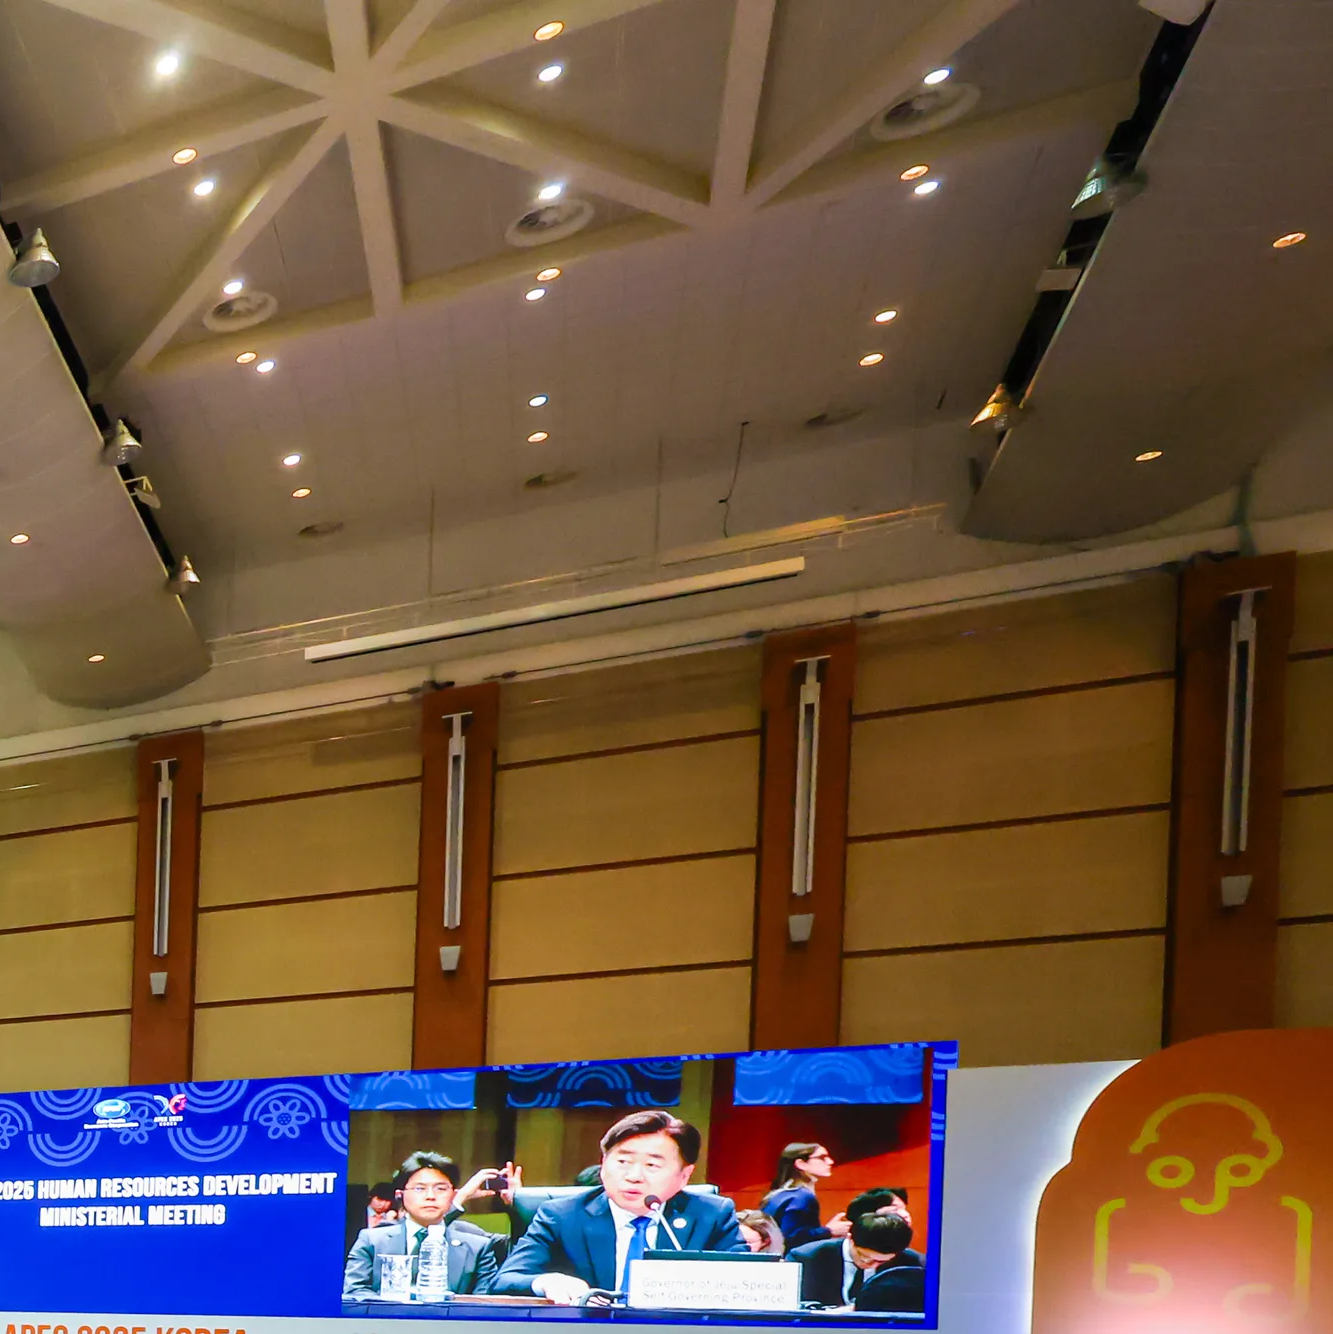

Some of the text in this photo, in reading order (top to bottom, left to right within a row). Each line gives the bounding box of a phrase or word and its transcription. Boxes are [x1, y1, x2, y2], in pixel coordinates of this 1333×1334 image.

[37, 1177, 97, 1200] HUMAN
[100, 1175, 199, 1199] RESOURCES
[202, 1172, 337, 1198] DEVELOPMENT
[39, 1203, 226, 1227] MINISTERIAL MEETING
